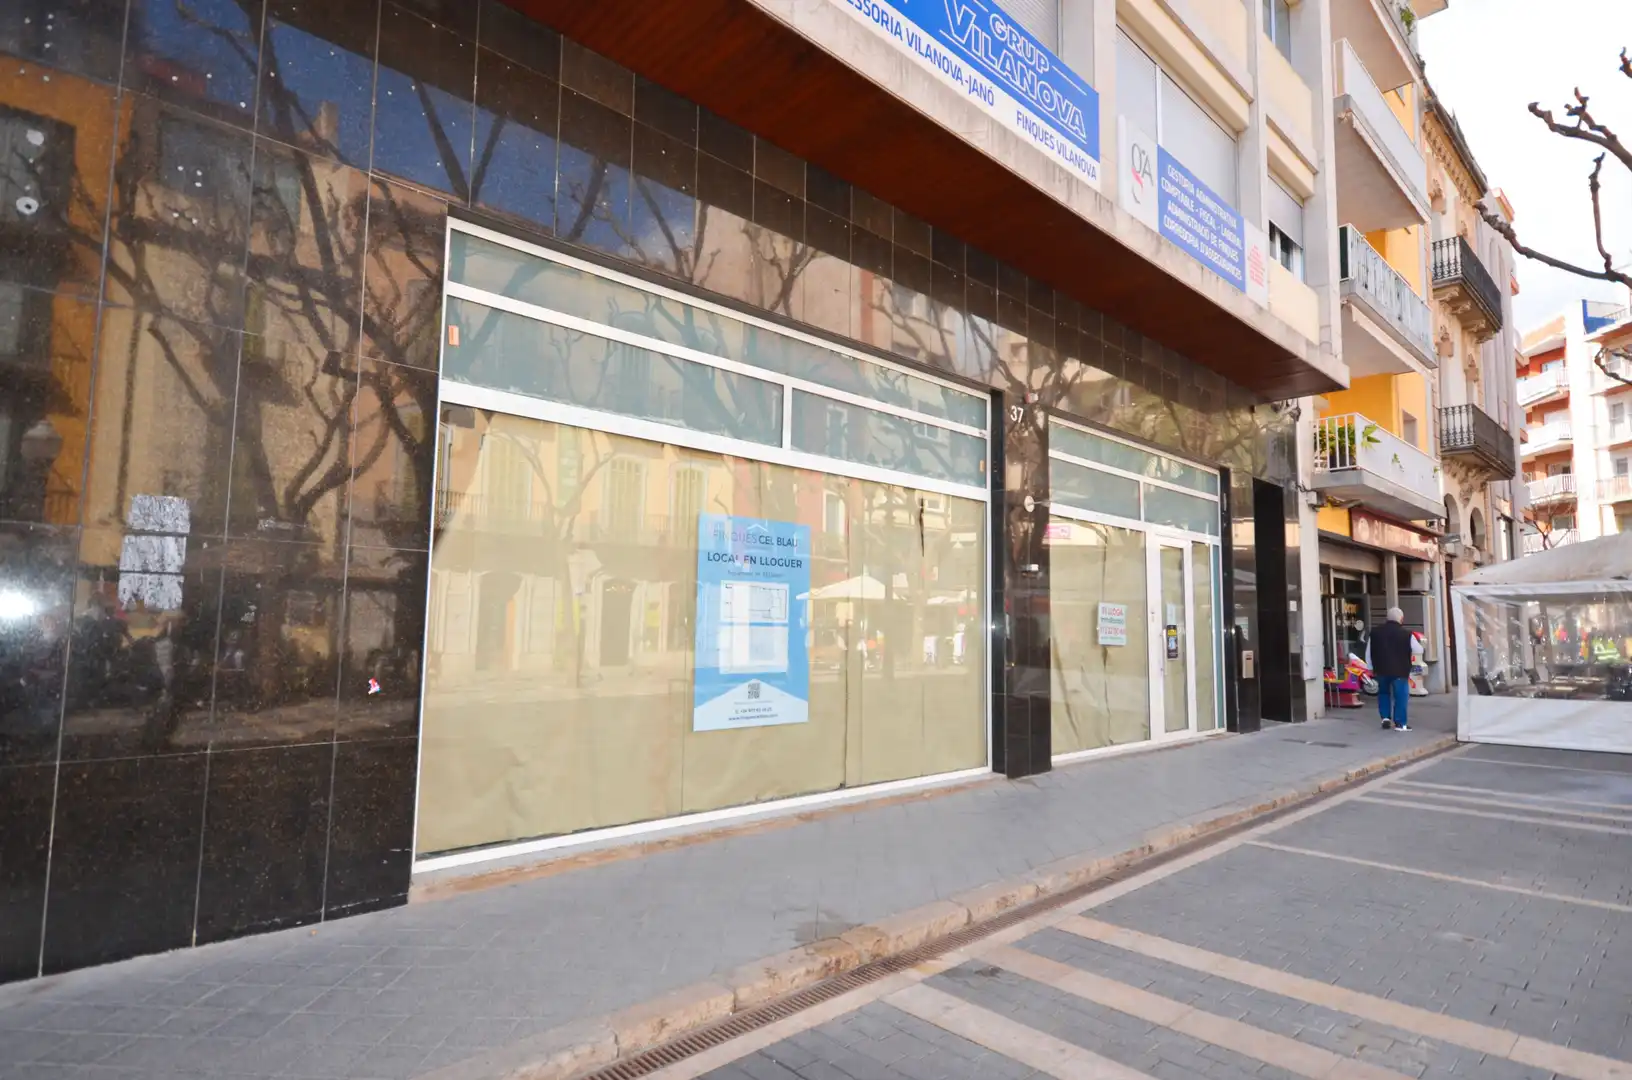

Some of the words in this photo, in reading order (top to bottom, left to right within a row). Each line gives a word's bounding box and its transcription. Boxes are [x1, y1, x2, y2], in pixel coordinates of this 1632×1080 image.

[846, 0, 904, 42] SSORIA
[989, 13, 1050, 74] GRUP
[944, 0, 1088, 139] VILANOVA
[1016, 110, 1056, 150] FINQUES
[1056, 139, 1097, 181] VILANOVA
[1160, 176, 1195, 213] COMPTABLE
[1199, 207, 1217, 230] FISCAL
[1220, 223, 1243, 250] LABORAL
[1167, 164, 1195, 196] GESTORIA
[1196, 187, 1237, 229] ADMINISTRATIVA
[1163, 214, 1199, 251] CORREDORIA
[1210, 233, 1218, 246] DE
[1218, 239, 1239, 263] FINQUES
[1010, 405, 1024, 423] 37
[758, 534, 774, 546] CEL
[776, 536, 798, 547] BLAU
[743, 555, 757, 565] EN
[759, 556, 803, 569] LLOGUER
